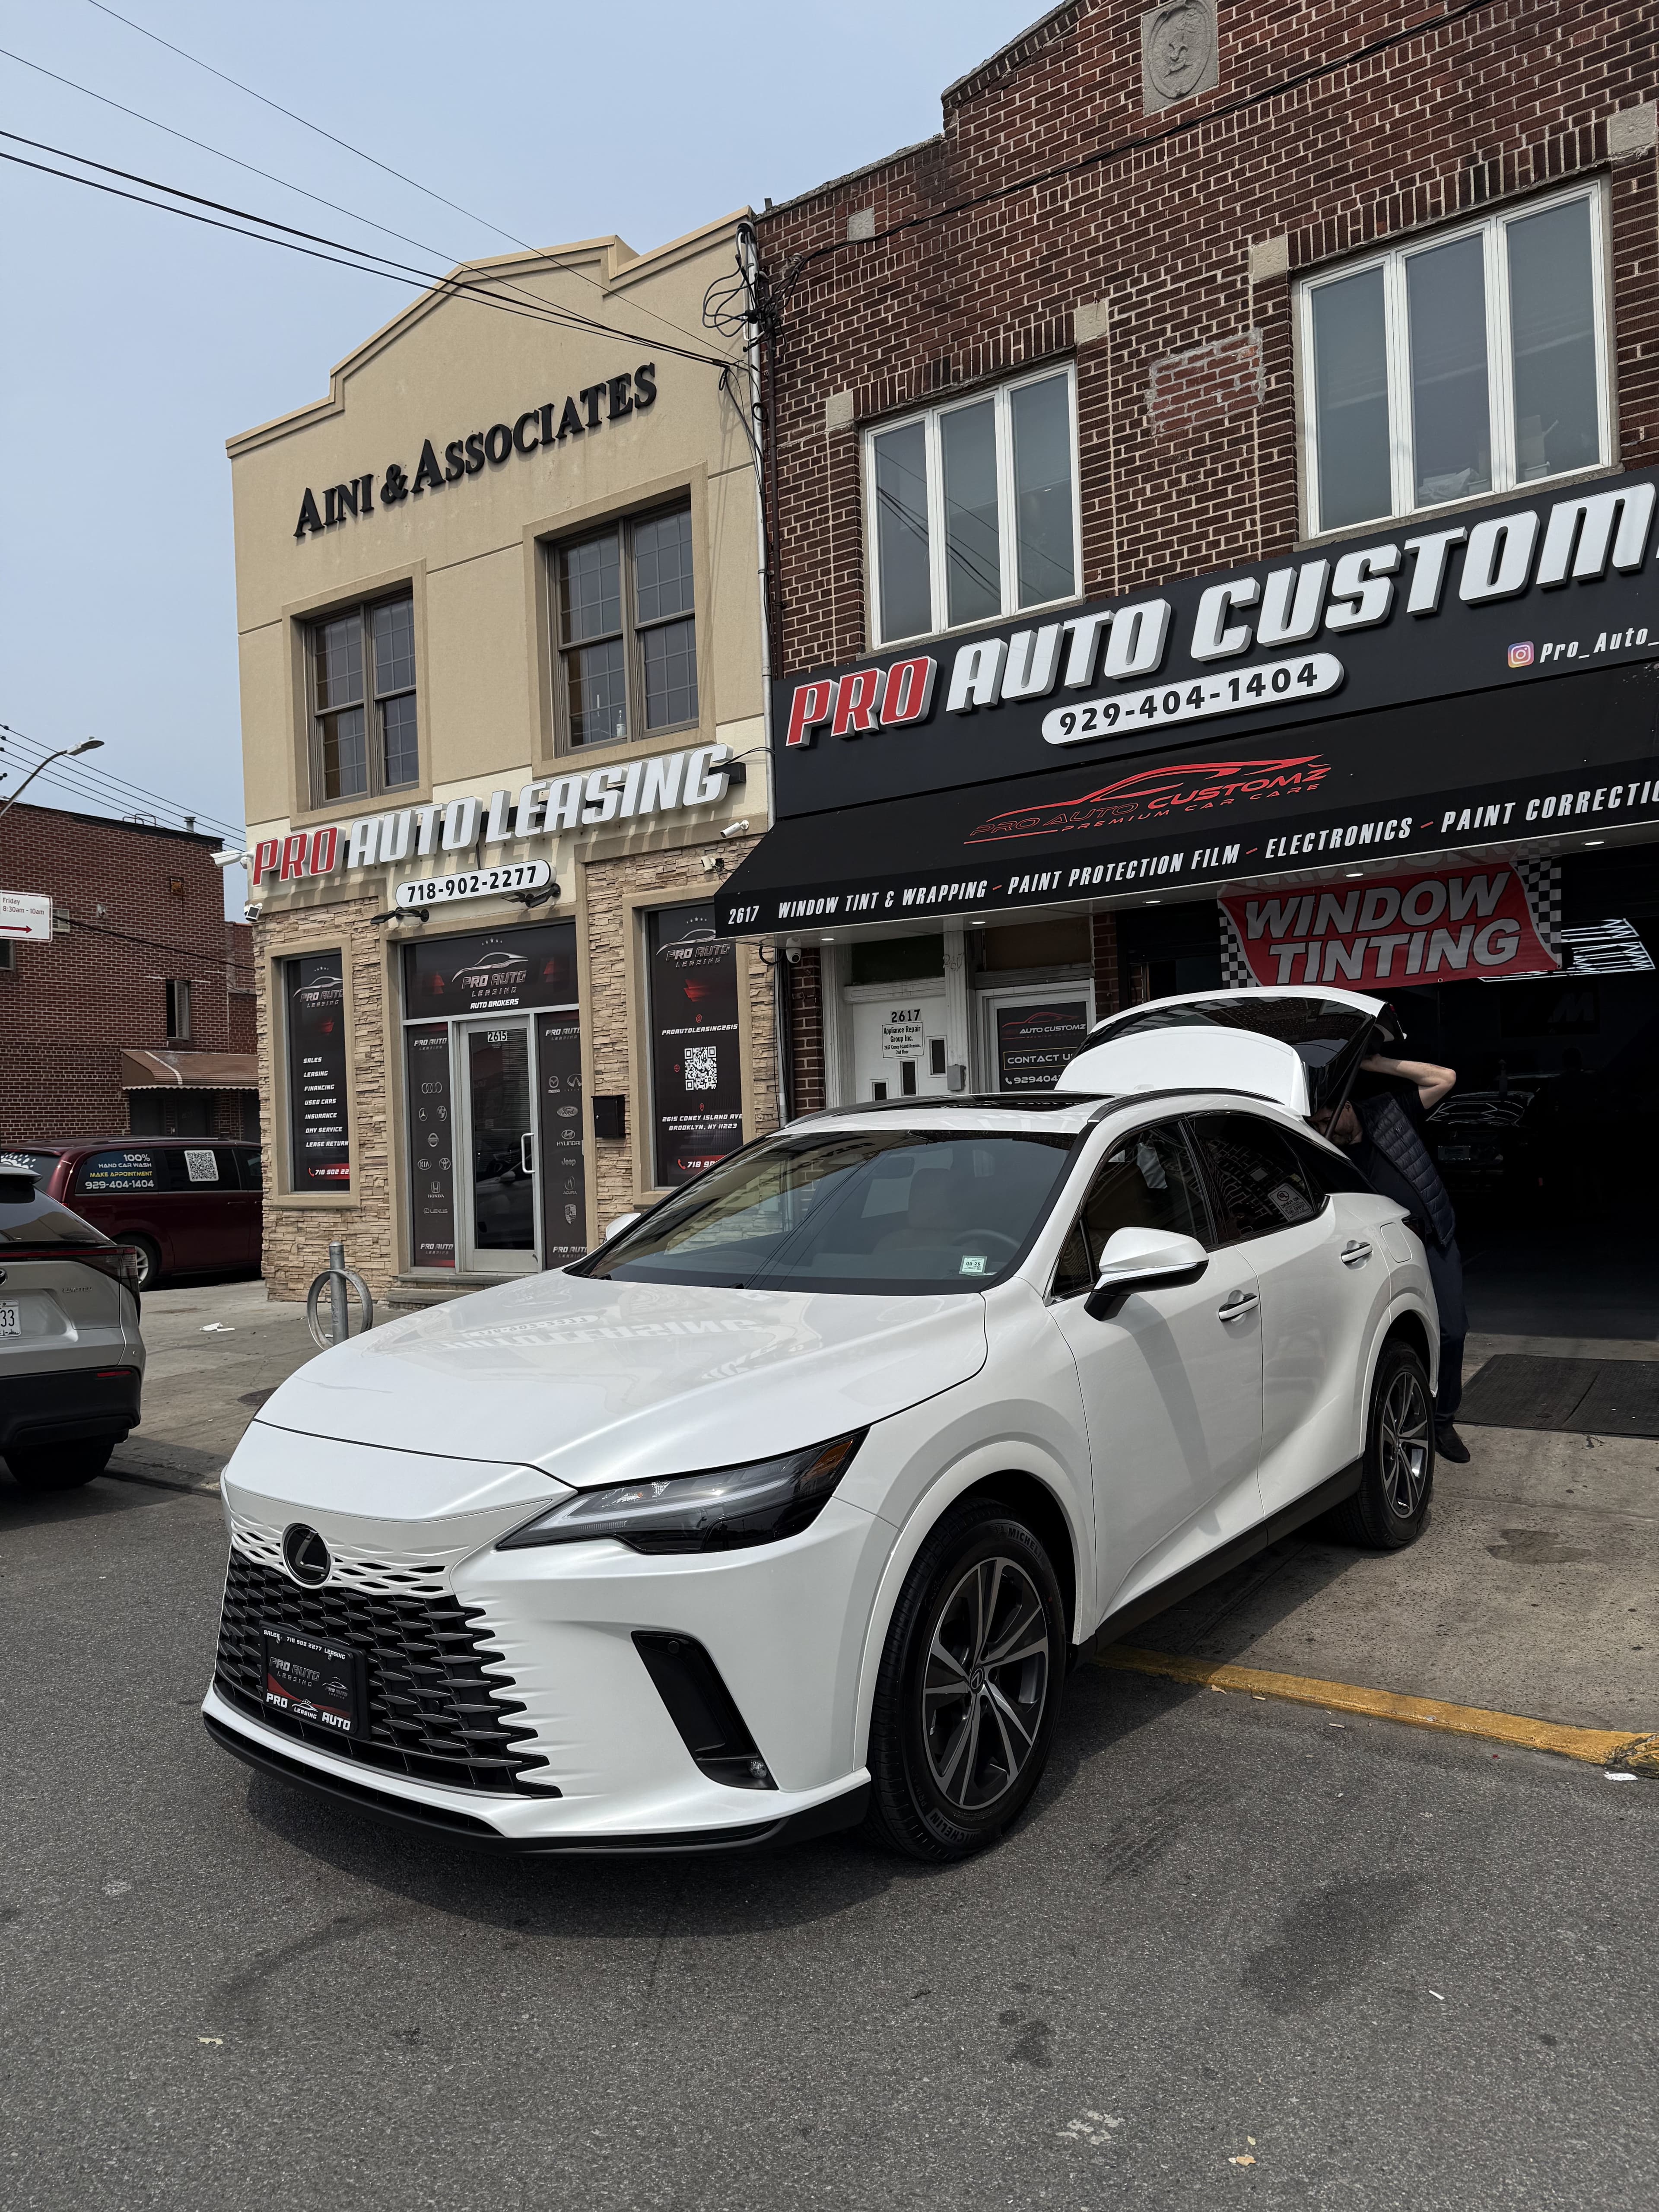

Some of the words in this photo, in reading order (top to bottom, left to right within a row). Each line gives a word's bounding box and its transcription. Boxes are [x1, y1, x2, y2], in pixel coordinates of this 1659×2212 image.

[293, 474, 374, 537] AINI
[380, 464, 408, 504] &
[410, 362, 658, 494] ASSOCIATES
[786, 655, 937, 749] PRO
[946, 598, 1171, 714] AUTO
[1190, 482, 1659, 662] CUSTOM
[1539, 628, 1659, 664] Pro_Auto_
[1059, 663, 1318, 736] 929-404-1404
[970, 817, 1040, 836] PRO
[1042, 803, 1138, 826] AUTO
[1147, 766, 1331, 809] CUSTOMZ
[1062, 810, 1170, 831] PREMIUM
[1185, 798, 1235, 811] CAR
[1250, 784, 1320, 800] CARE
[252, 825, 346, 887] PRO
[347, 796, 483, 869] AUTO
[485, 743, 733, 843] LEASING
[728, 905, 760, 925] 2617
[778, 896, 839, 919] WINDOW
[845, 892, 879, 912] TINT
[885, 891, 894, 907] &
[902, 880, 988, 906] WRAPPING
[1007, 871, 1062, 895] PAINT
[1068, 852, 1184, 887] PROTECTION
[1192, 843, 1240, 870] FILM
[1265, 817, 1413, 858] ELECTRONICS
[1441, 802, 1516, 833] PAINT
[408, 865, 536, 903] 718-902-2277
[1245, 871, 1513, 941] WINDOW
[666, 948, 693, 961] PRO
[695, 944, 731, 958] AUTO
[1268, 918, 1521, 986] TINTING
[676, 957, 721, 968] LEASING
[461, 975, 489, 989] PRO
[491, 970, 527, 986] AUTO
[300, 992, 319, 1002] PRO
[472, 986, 517, 998] LEASING
[307, 1000, 339, 1008] LEASING
[470, 1001, 487, 1010] AUTO
[488, 998, 519, 1008] BROKERS
[696, 1014, 702, 1023] @
[891, 1009, 921, 1023] 2617
[488, 1031, 506, 1041] 2615
[661, 1023, 738, 1036] PROAUTOLEASING2615
[884, 1027, 904, 1036] Appliance
[906, 1025, 921, 1033] Repair
[1044, 1023, 1086, 1033] CUSTOMZ
[429, 1037, 448, 1046] AUTO
[1007, 1054, 1060, 1064] CONTACT
[1014, 1075, 1061, 1084] 929404
[561, 1157, 576, 1166] Jeep
[85, 1179, 154, 1189] 929-404-1404
[1008, 1527, 1043, 1561] MICHELI
[308, 1643, 322, 1651] 2277
[324, 1648, 346, 1660] LEASING
[269, 1656, 290, 1672] PRO
[292, 1664, 320, 1681] AUTO
[277, 1671, 313, 1687] LEASING
[266, 1692, 288, 1708] PRO
[294, 1707, 318, 1719] LEASING
[321, 1712, 351, 1731] AUTO
